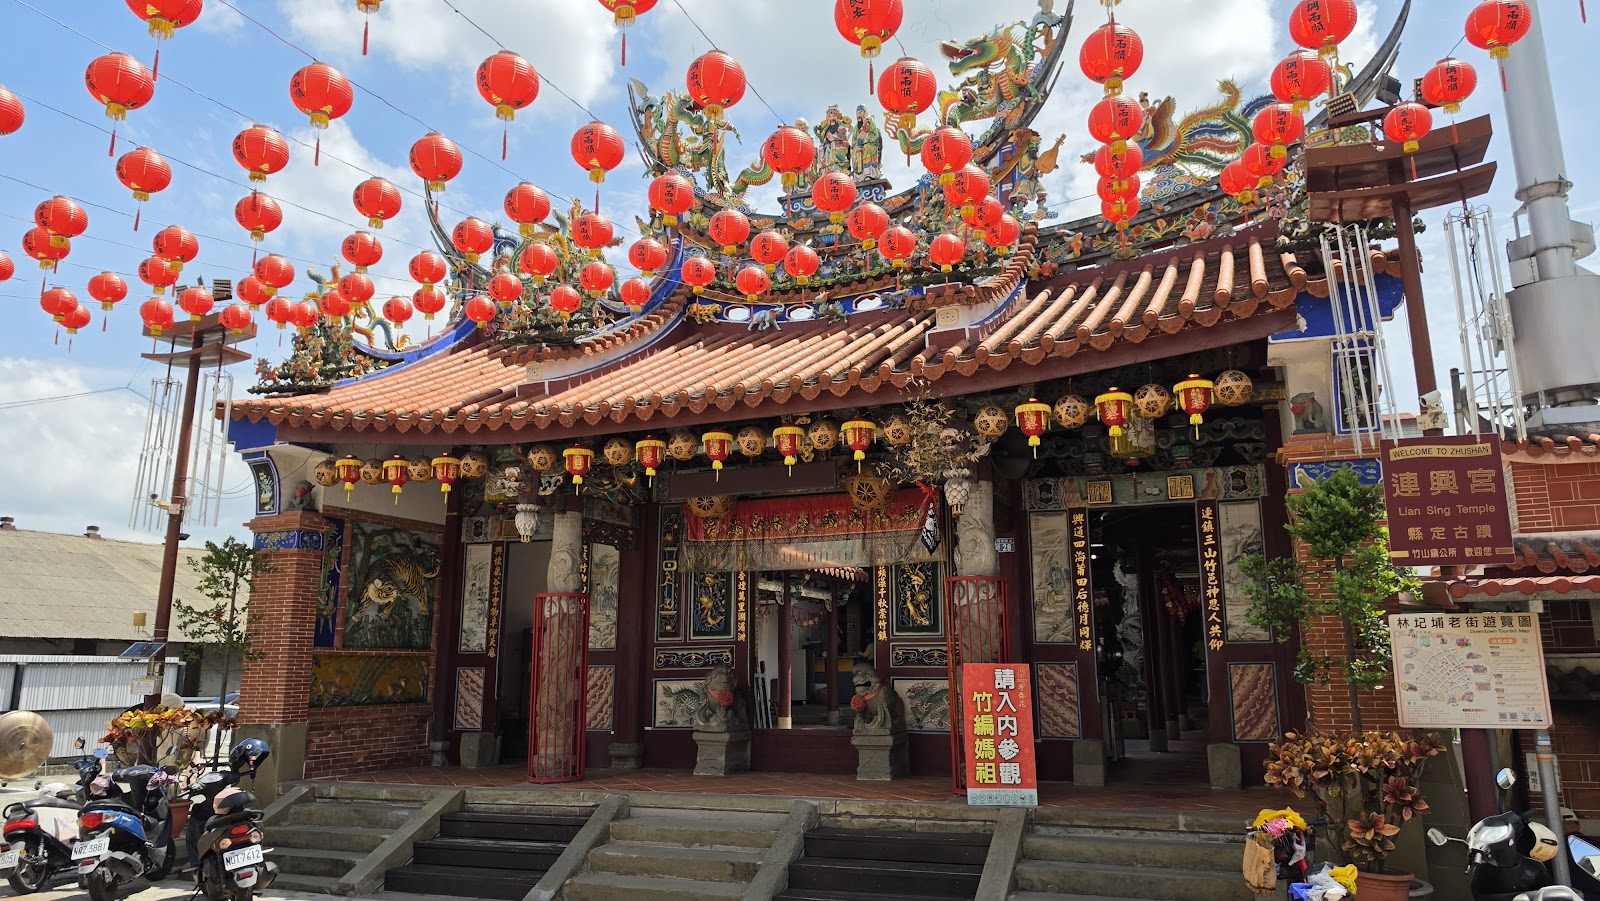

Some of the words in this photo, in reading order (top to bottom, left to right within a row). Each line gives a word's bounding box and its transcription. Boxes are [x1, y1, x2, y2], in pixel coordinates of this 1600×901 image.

[1392, 447, 1433, 458] WELCOME
[1436, 447, 1447, 455] TO
[1450, 446, 1489, 456] ZHUSHAN
[1391, 467, 1496, 497] 連興宮
[1398, 507, 1420, 516] Lian
[1426, 505, 1451, 517] Sing
[1456, 503, 1496, 515] Temple
[1407, 524, 1492, 541] 縣定古蹟
[1002, 543, 1012, 552] 28
[1412, 547, 1457, 559] 竹山鎮公所
[1464, 546, 1492, 557] 歡迎您
[1396, 615, 1532, 629] 林圮埔老街遊覽圖
[994, 668, 1022, 785] 請入內參觀
[972, 691, 997, 785] 竹編媽祖
